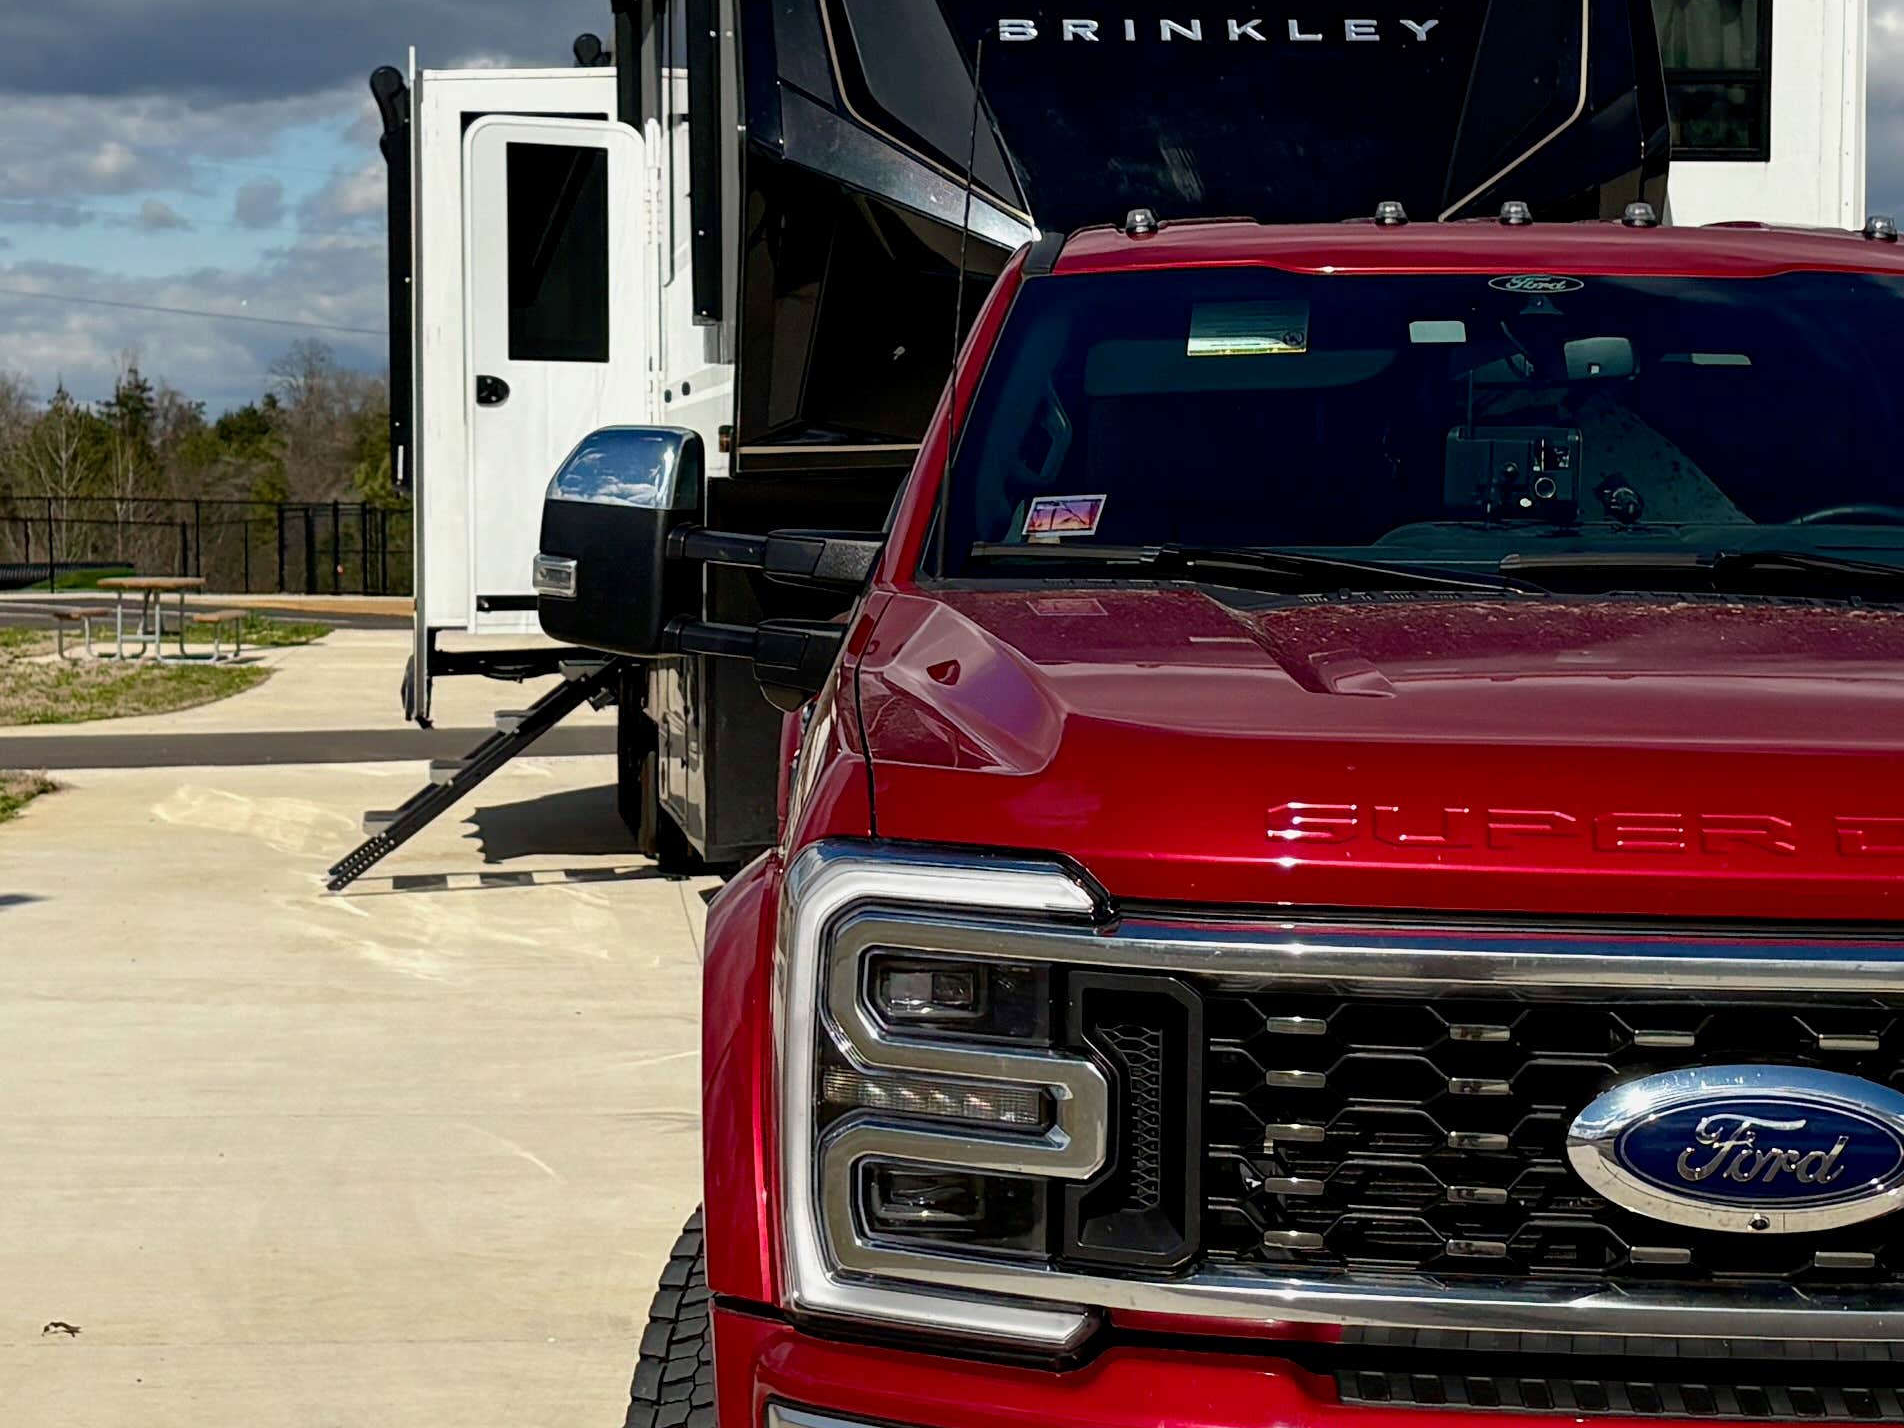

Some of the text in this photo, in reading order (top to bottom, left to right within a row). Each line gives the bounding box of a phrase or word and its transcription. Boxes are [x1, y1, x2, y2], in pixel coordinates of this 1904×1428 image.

[998, 18, 1440, 42] BRINKLEY
[1505, 275, 1567, 290] Ford
[1264, 800, 1796, 858] SUPER
[1676, 1113, 1849, 1184] Ford
